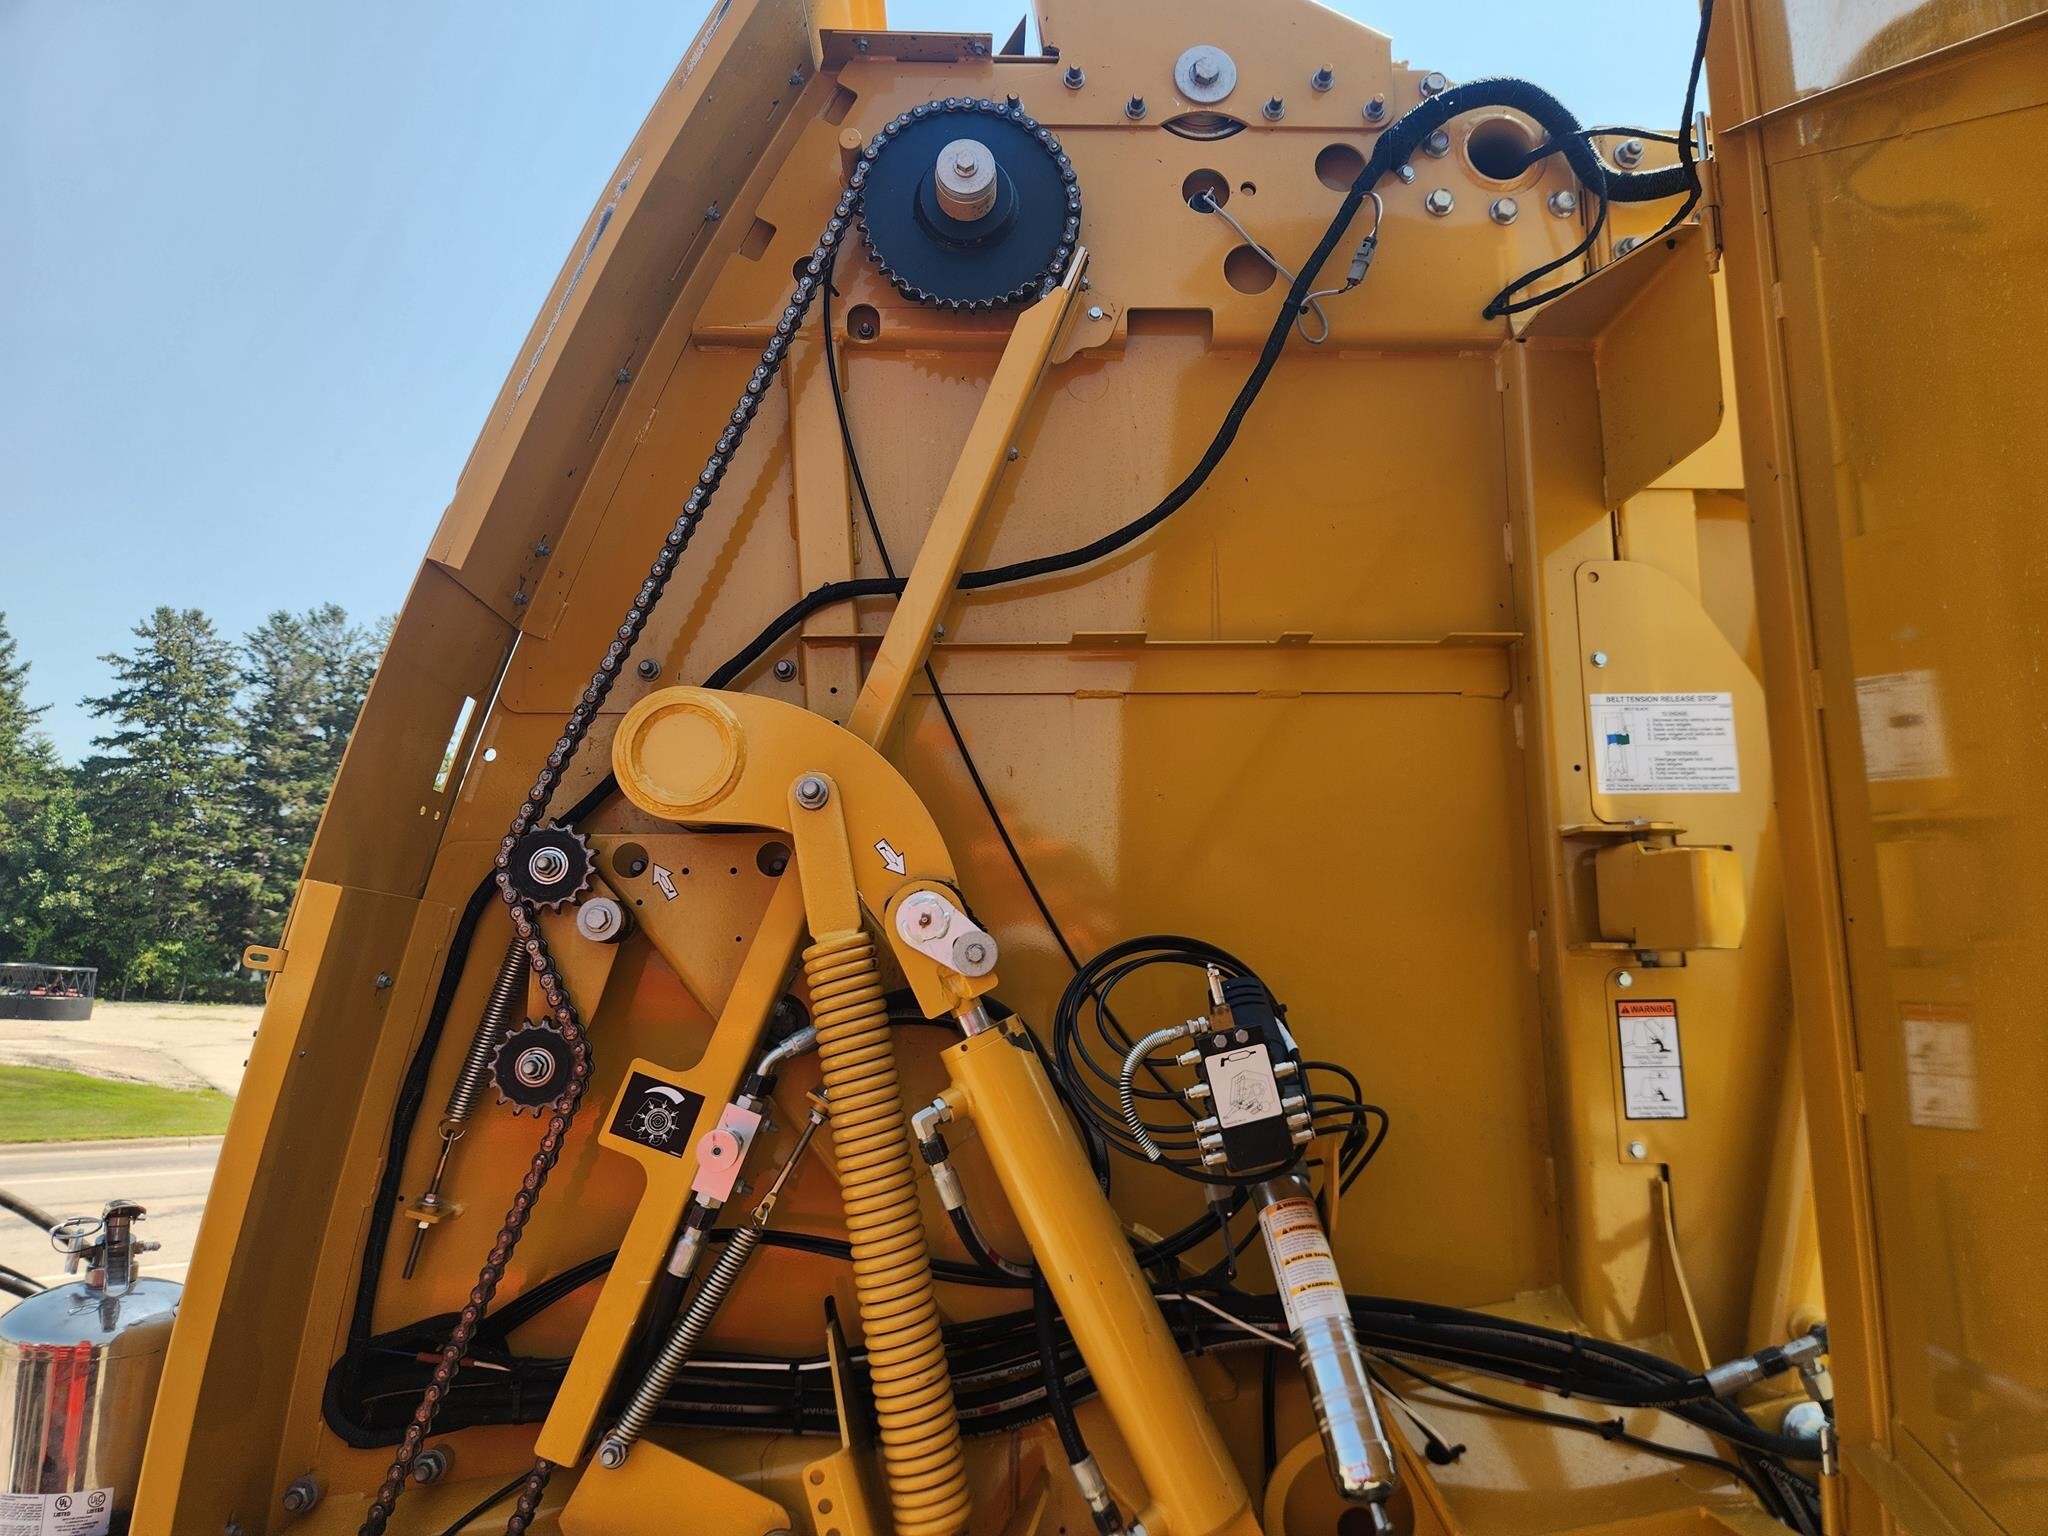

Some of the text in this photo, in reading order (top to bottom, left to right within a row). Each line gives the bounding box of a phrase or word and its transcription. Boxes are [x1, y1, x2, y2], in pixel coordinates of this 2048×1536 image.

[1606, 695, 1624, 703] BELT
[1626, 695, 1659, 703] TENSION
[1630, 1004, 1673, 1014] WARNING
[86, 1506, 105, 1515] LISTED
